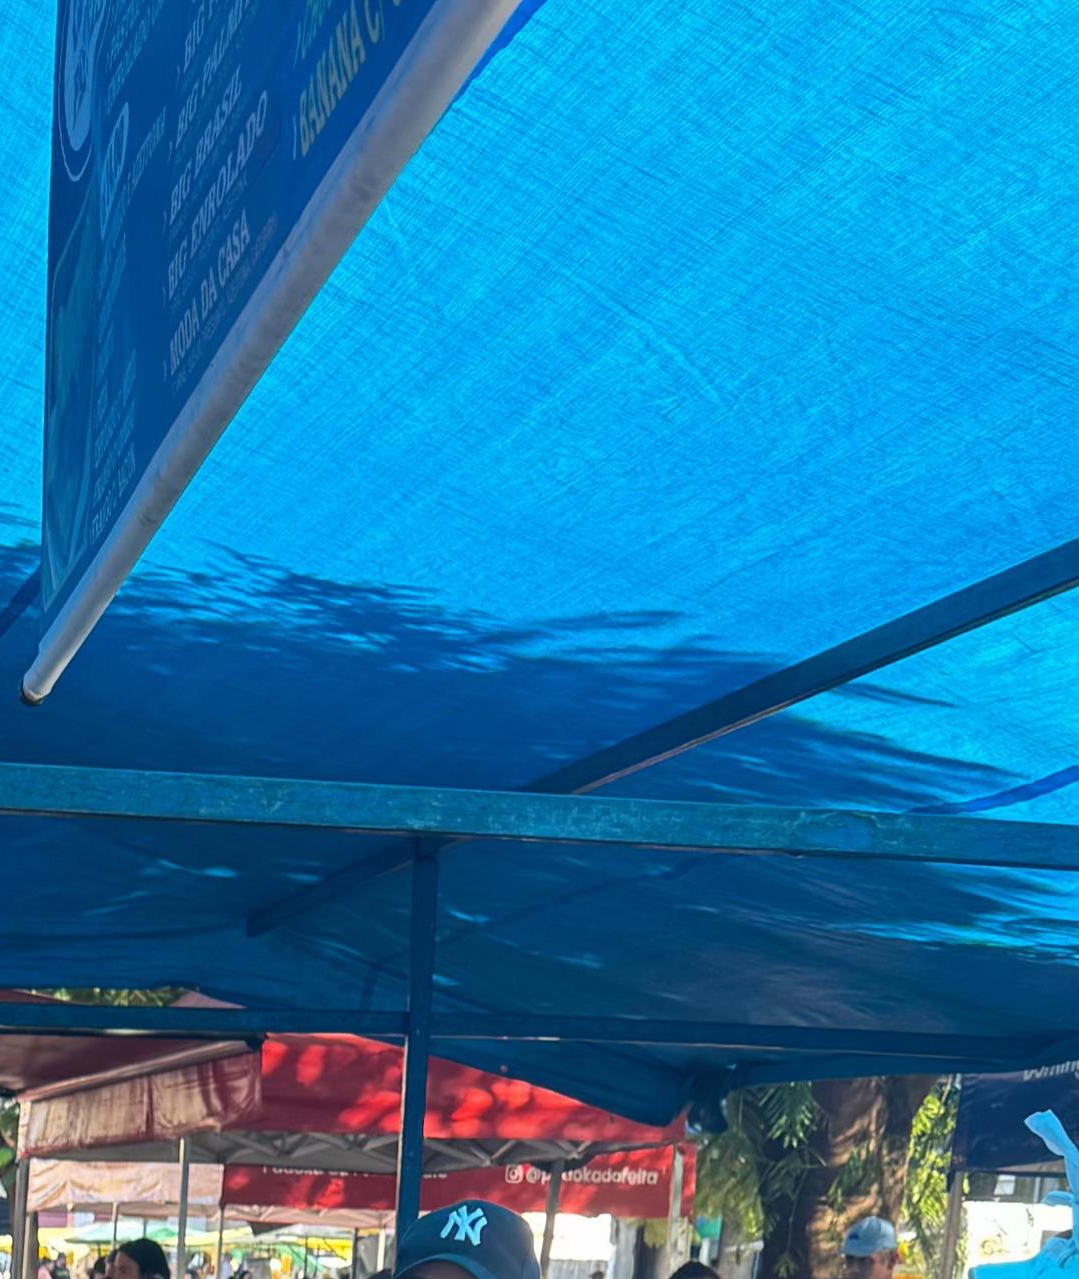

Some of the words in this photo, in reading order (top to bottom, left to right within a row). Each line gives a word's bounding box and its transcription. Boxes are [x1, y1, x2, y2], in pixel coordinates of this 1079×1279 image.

[170, 159, 192, 225] BIG
[194, 63, 242, 179] BRASIL
[176, 79, 199, 149] BIG
[299, 0, 367, 157] BANANA
[168, 238, 188, 300] BIG
[190, 89, 268, 259] ENROLADO
[170, 297, 200, 376] MODA
[200, 266, 218, 320] DA
[217, 208, 250, 288] CASA
[440, 1204, 488, 1246] NY
